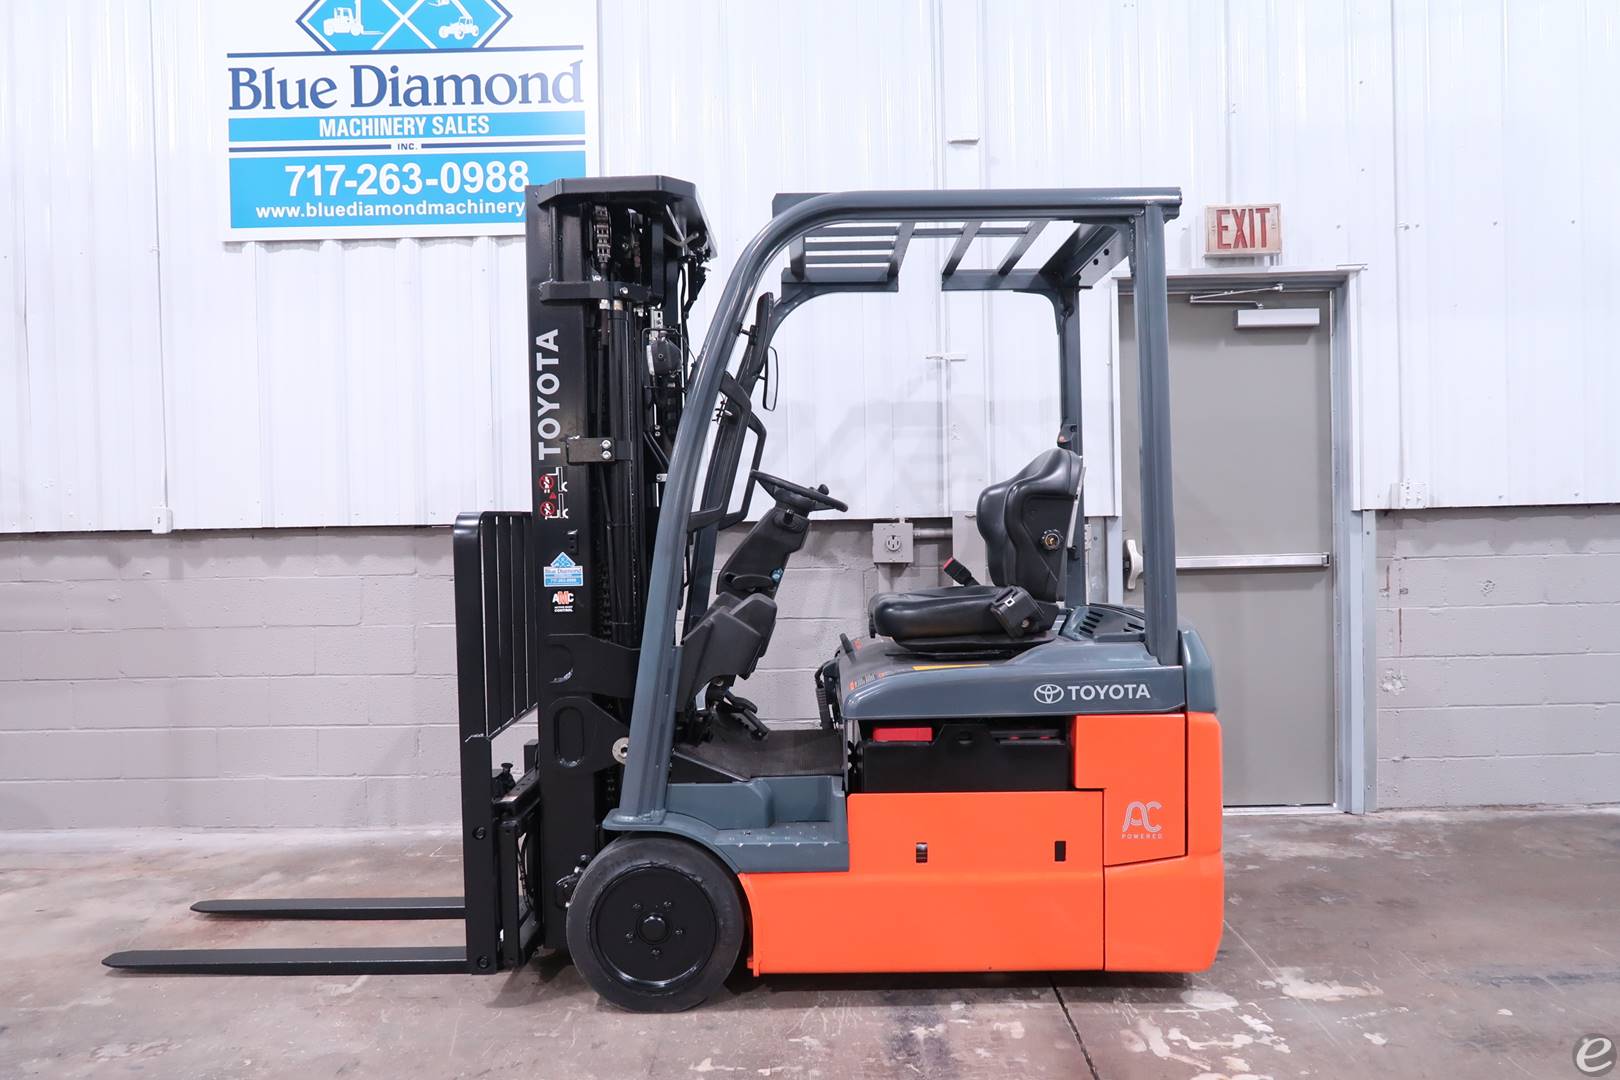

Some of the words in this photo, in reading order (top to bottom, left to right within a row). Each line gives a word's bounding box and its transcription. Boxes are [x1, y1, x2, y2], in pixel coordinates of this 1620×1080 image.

[228, 67, 337, 110] Blue
[350, 60, 583, 108] Diamond
[319, 117, 426, 137] MACHINERY
[432, 115, 489, 135] SALES
[284, 160, 529, 196] 717-263-0988
[1216, 208, 1270, 249] EXIT
[535, 328, 561, 461] TOYOTA
[1067, 684, 1151, 700] TOYOTA
[1122, 801, 1162, 832] AC
